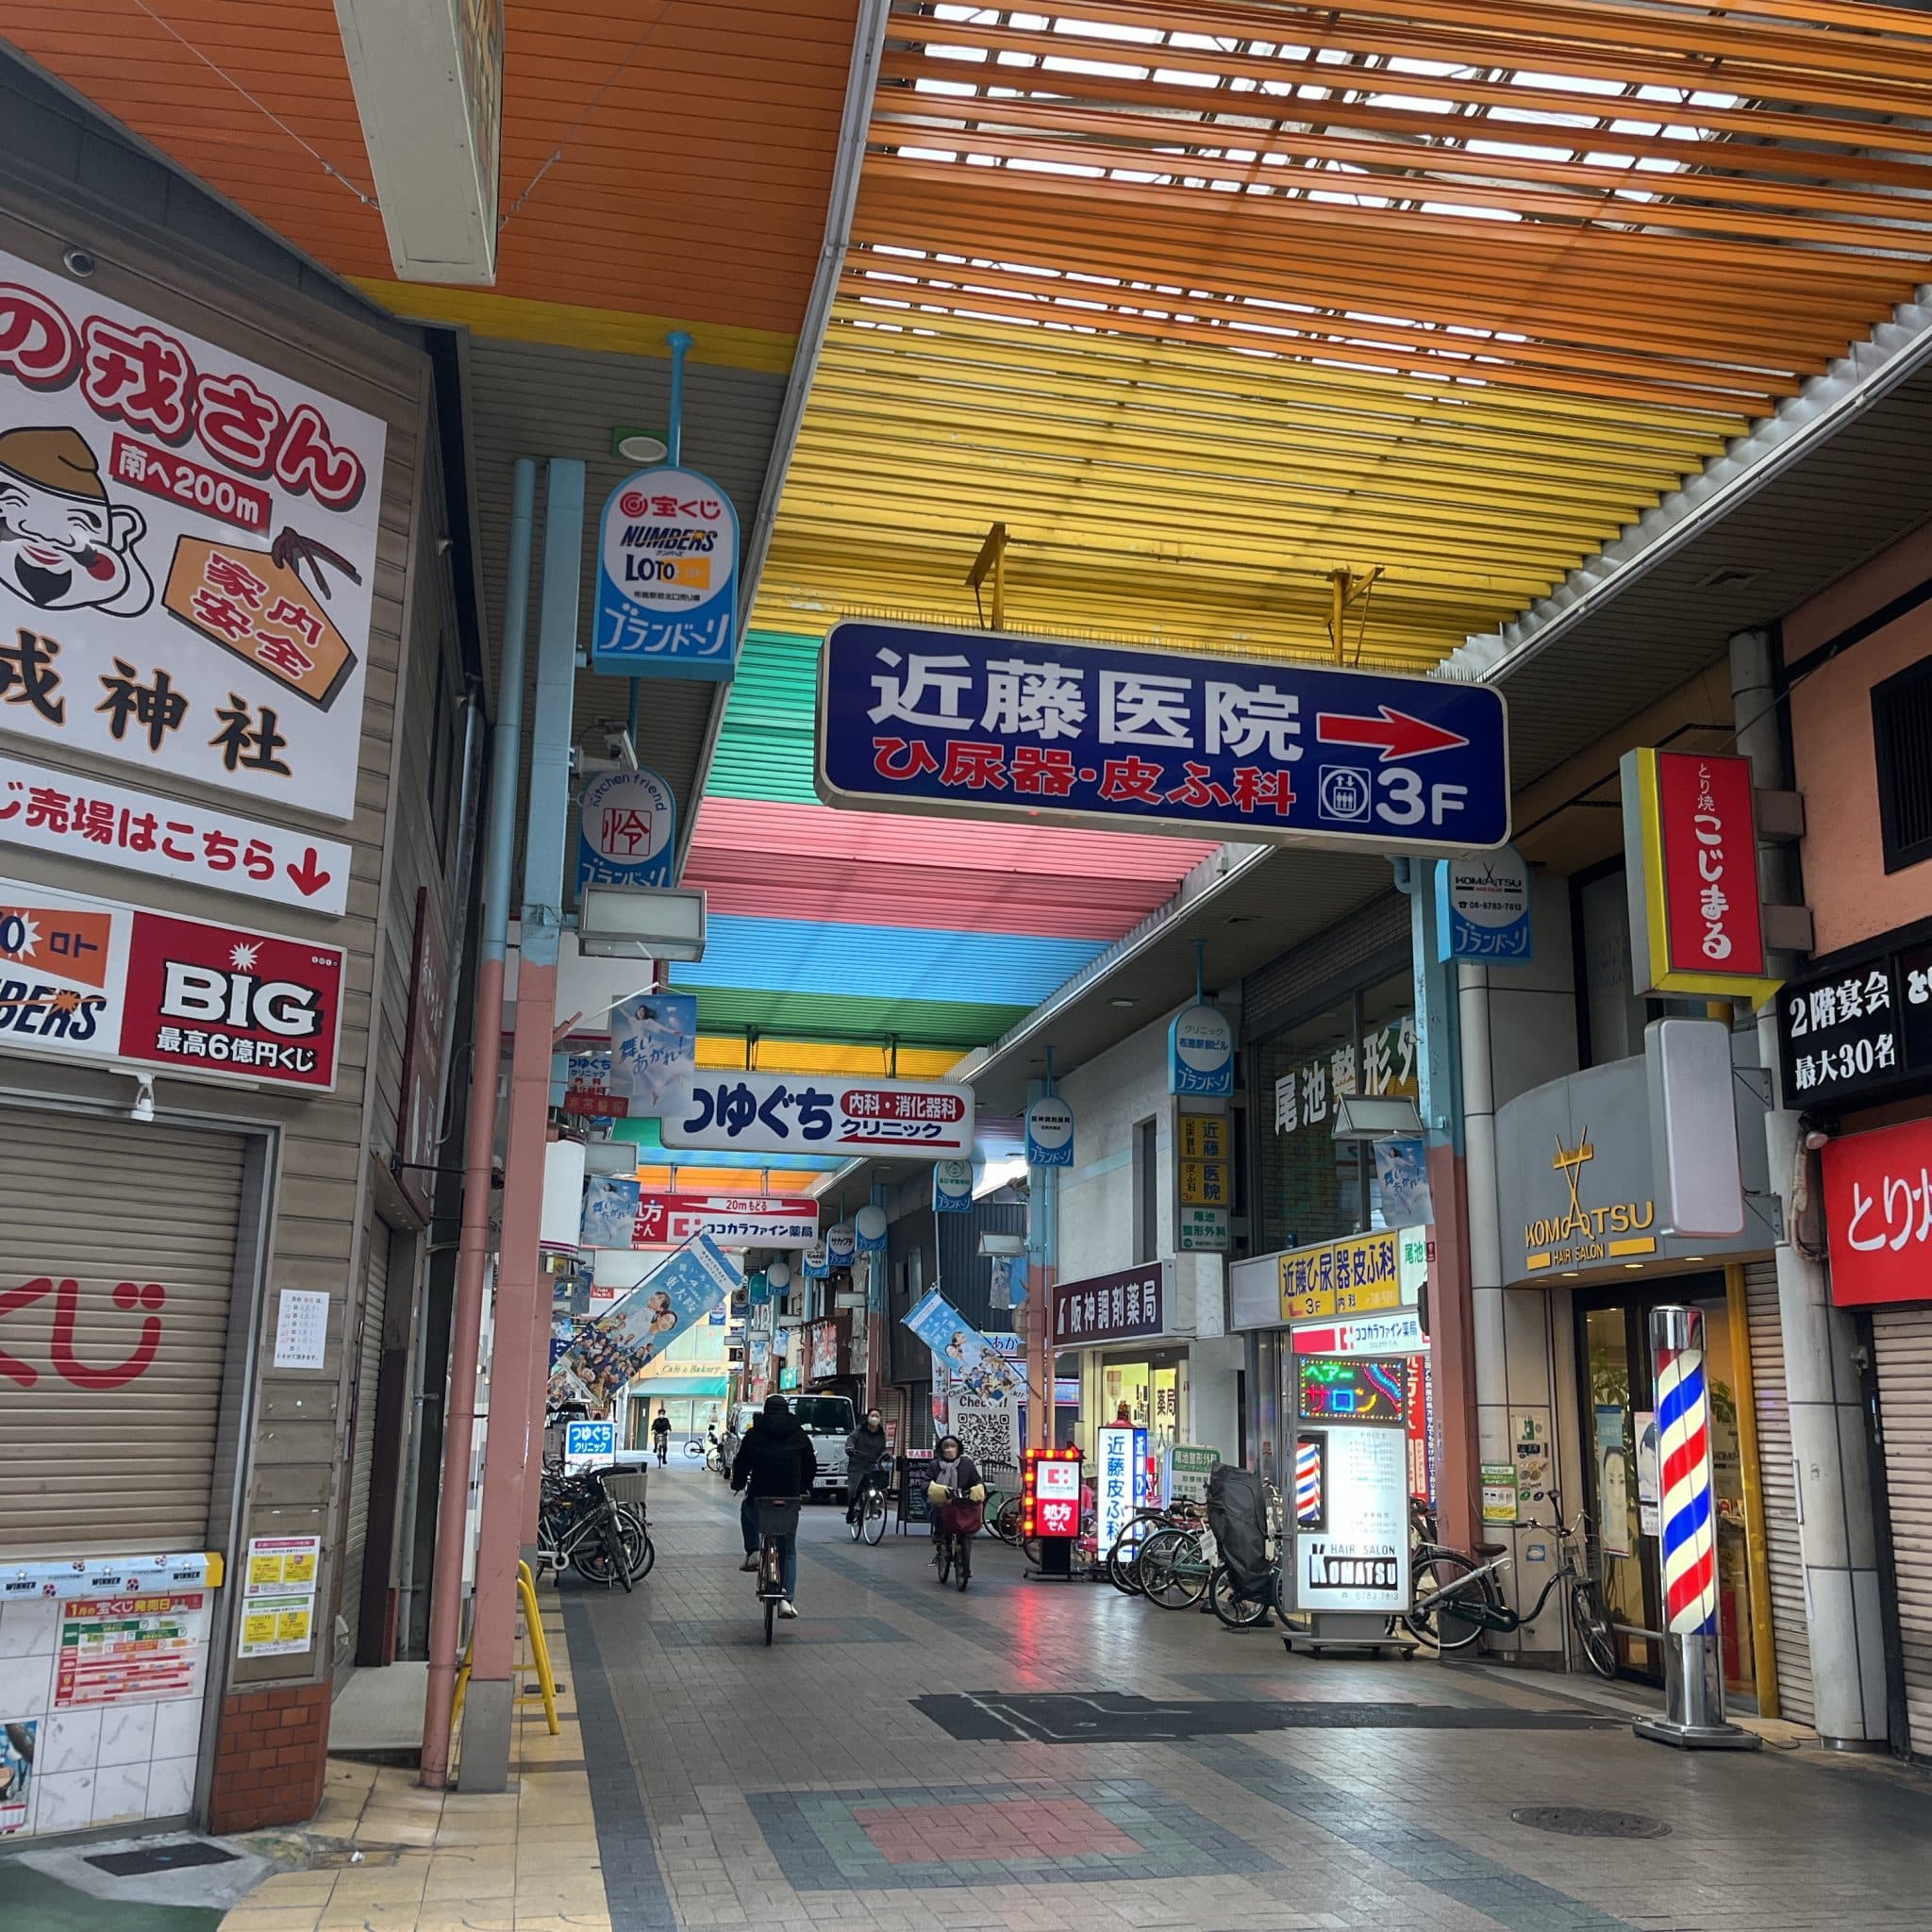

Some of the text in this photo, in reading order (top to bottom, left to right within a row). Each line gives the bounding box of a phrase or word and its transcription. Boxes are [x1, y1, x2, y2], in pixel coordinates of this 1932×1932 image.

[118, 444, 258, 525] 南へ200m
[651, 496, 721, 519] 宝くじ
[620, 525, 718, 552] NUMBERS
[625, 554, 675, 581] LOTO
[205, 550, 325, 647] 家内
[192, 589, 315, 680] 安全
[867, 647, 1304, 761] 近藤医院
[634, 774, 667, 811] friend
[872, 736, 1297, 817] ひ尿器・皮ふ科
[1698, 762, 1715, 812] とり焼
[1375, 767, 1469, 826] 3F
[1694, 814, 1732, 960] こじまる
[50, 932, 98, 958] ロト
[0, 978, 107, 1041] BERS
[159, 959, 319, 1036] BIG
[1790, 971, 1890, 1038] 2階宴会
[157, 1026, 315, 1074] 最高6億円くじ
[1795, 1034, 1895, 1091] 最大30名
[683, 1083, 834, 1141] つゆぐち
[849, 1092, 957, 1120] 内科・消化器科
[841, 1119, 942, 1139] クリニック
[1203, 1122, 1221, 1200] 近藤医院
[725, 1199, 768, 1211] 20m もどる
[707, 1224, 813, 1239] ココカラファイン薬局
[1525, 1201, 1654, 1249] KOMATSU
[1283, 1241, 1396, 1298] 近藤ひ尿器・皮ふ科
[1553, 1243, 1604, 1266] HAIR SALON
[1071, 1280, 1157, 1335] 阪神調剤薬局
[1306, 1298, 1321, 1314] 3F
[1338, 1293, 1356, 1311] 内科
[1356, 1321, 1418, 1341] ココカラファイン薬局
[1306, 1363, 1355, 1382] ヘアー
[1306, 1384, 1377, 1413] サロン
[572, 1425, 611, 1441] つゆぐち
[575, 1441, 607, 1453] クリニック
[1043, 1504, 1072, 1520] 処方
[1047, 1521, 1066, 1532] せん
[1311, 1543, 1396, 1585] KOMATSU
[1331, 1544, 1395, 1555] HAIR SALON
[71, 1598, 172, 1617] 1月の宝くじ発売日
